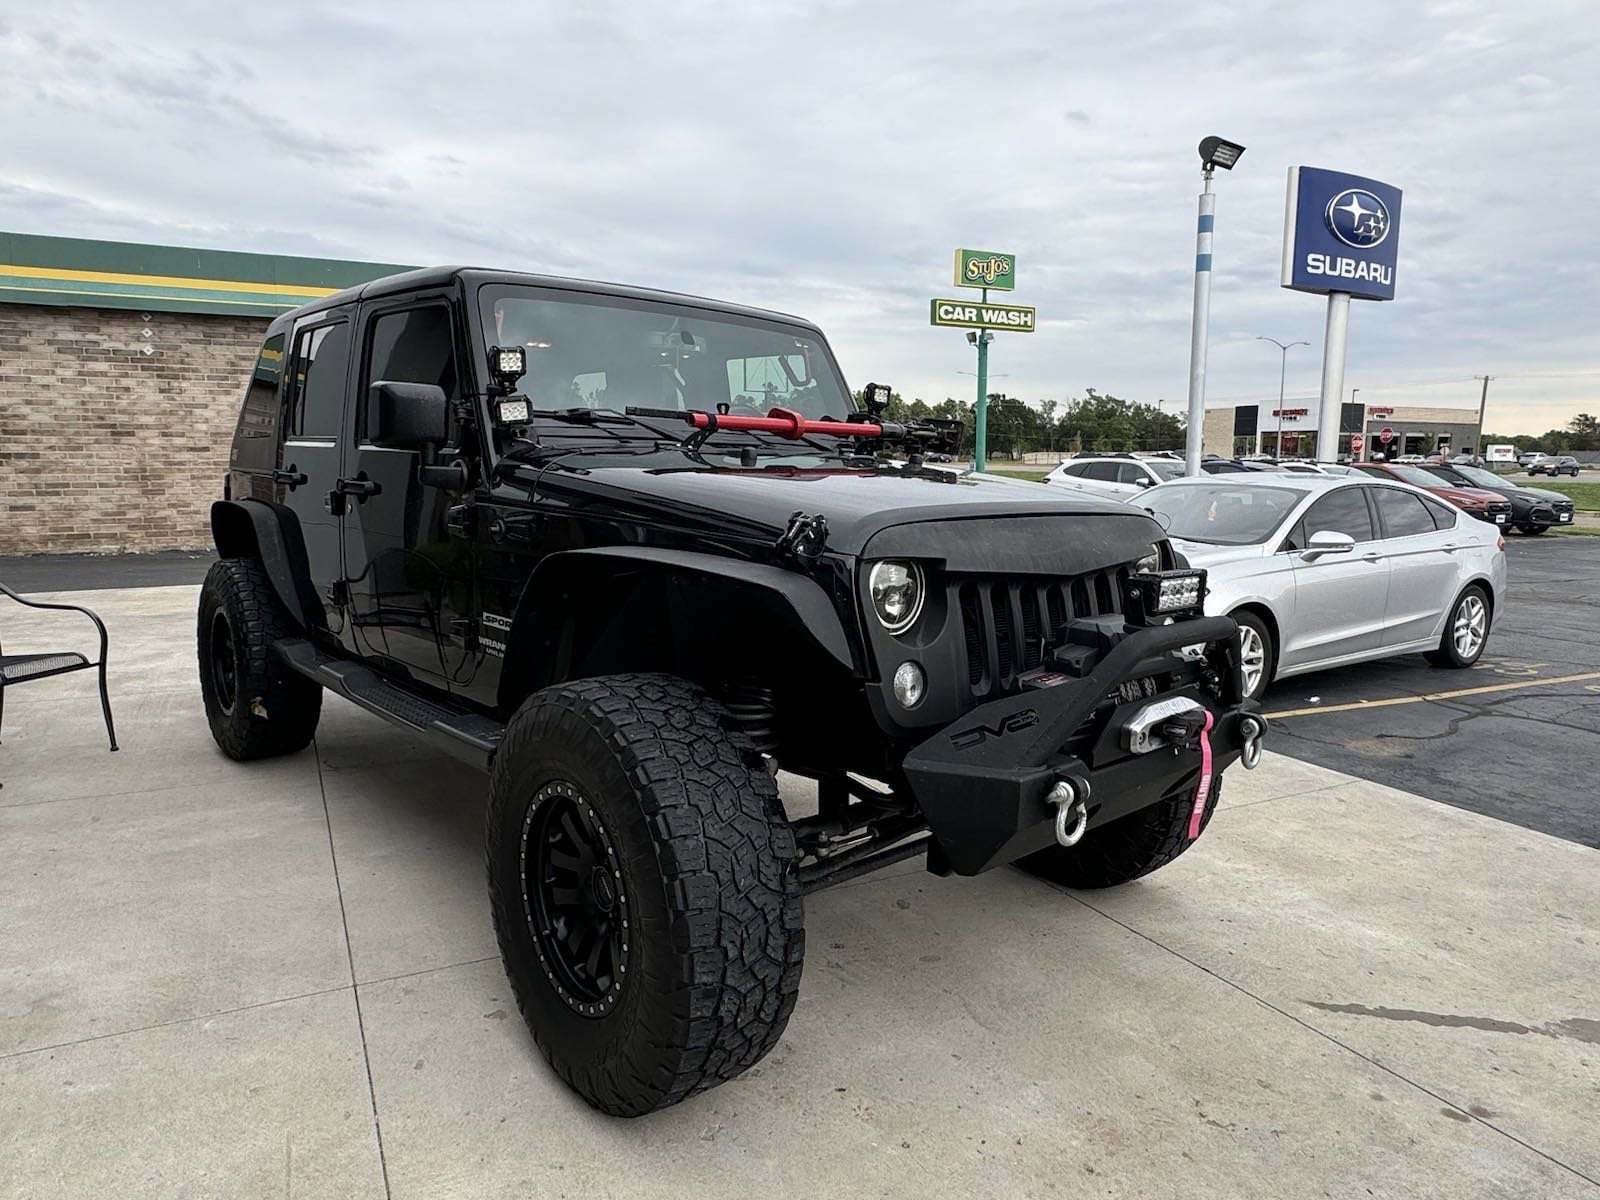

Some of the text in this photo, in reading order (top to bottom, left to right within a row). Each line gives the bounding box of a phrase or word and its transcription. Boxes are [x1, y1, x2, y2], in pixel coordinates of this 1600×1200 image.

[1306, 253, 1392, 285] SUBARU
[939, 305, 1031, 326] CAR WASH
